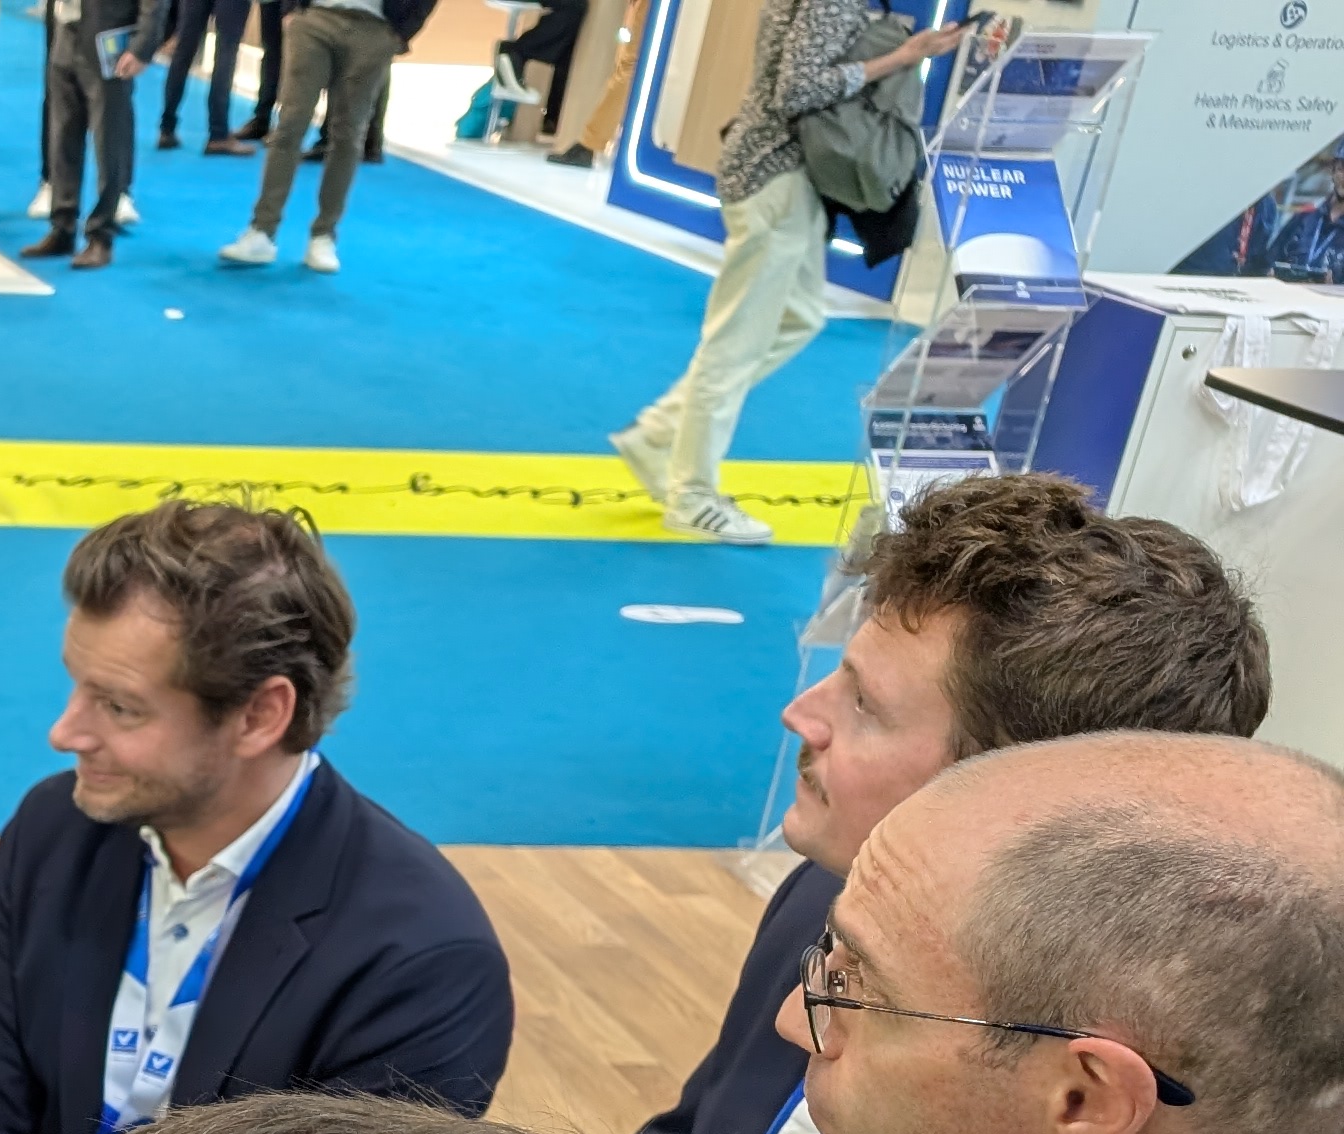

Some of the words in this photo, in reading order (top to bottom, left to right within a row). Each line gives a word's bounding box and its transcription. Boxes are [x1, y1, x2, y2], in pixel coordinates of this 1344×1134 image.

[1212, 30, 1270, 51] Logistics
[1272, 32, 1283, 48] &
[1285, 33, 1344, 52] Operatio
[1194, 92, 1238, 109] Health
[1296, 95, 1338, 115] Safety
[1205, 112, 1217, 129] &
[1219, 113, 1313, 132] Measurement
[942, 164, 1026, 184] NUCLEAR
[946, 180, 1013, 198] POWER
